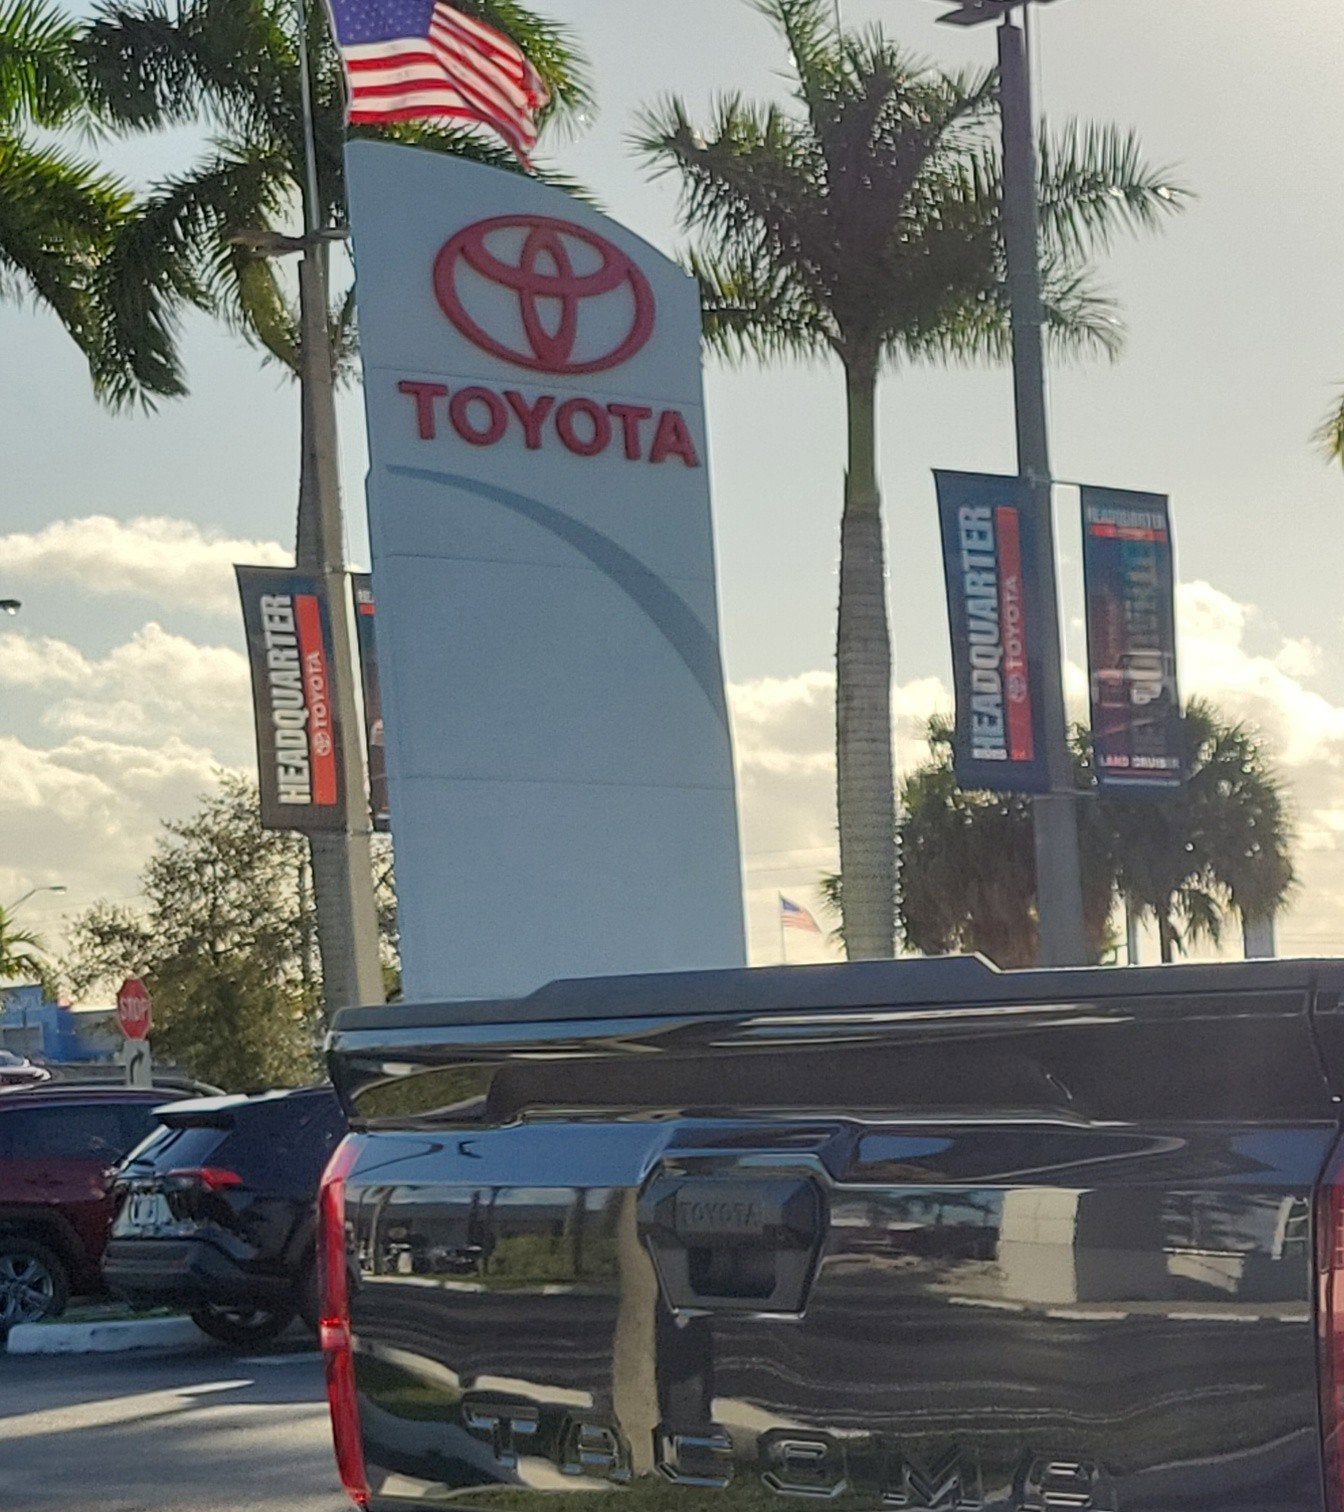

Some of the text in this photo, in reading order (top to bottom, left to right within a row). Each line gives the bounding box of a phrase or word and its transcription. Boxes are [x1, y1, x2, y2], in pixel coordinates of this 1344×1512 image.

[398, 379, 698, 467] TOYOTA
[959, 506, 1008, 760] HEADQUARTER
[1005, 576, 1023, 669] TOYOTA
[261, 594, 311, 804] HEADQUARTER
[306, 651, 328, 727] TOYOTA
[120, 996, 150, 1021] STOP
